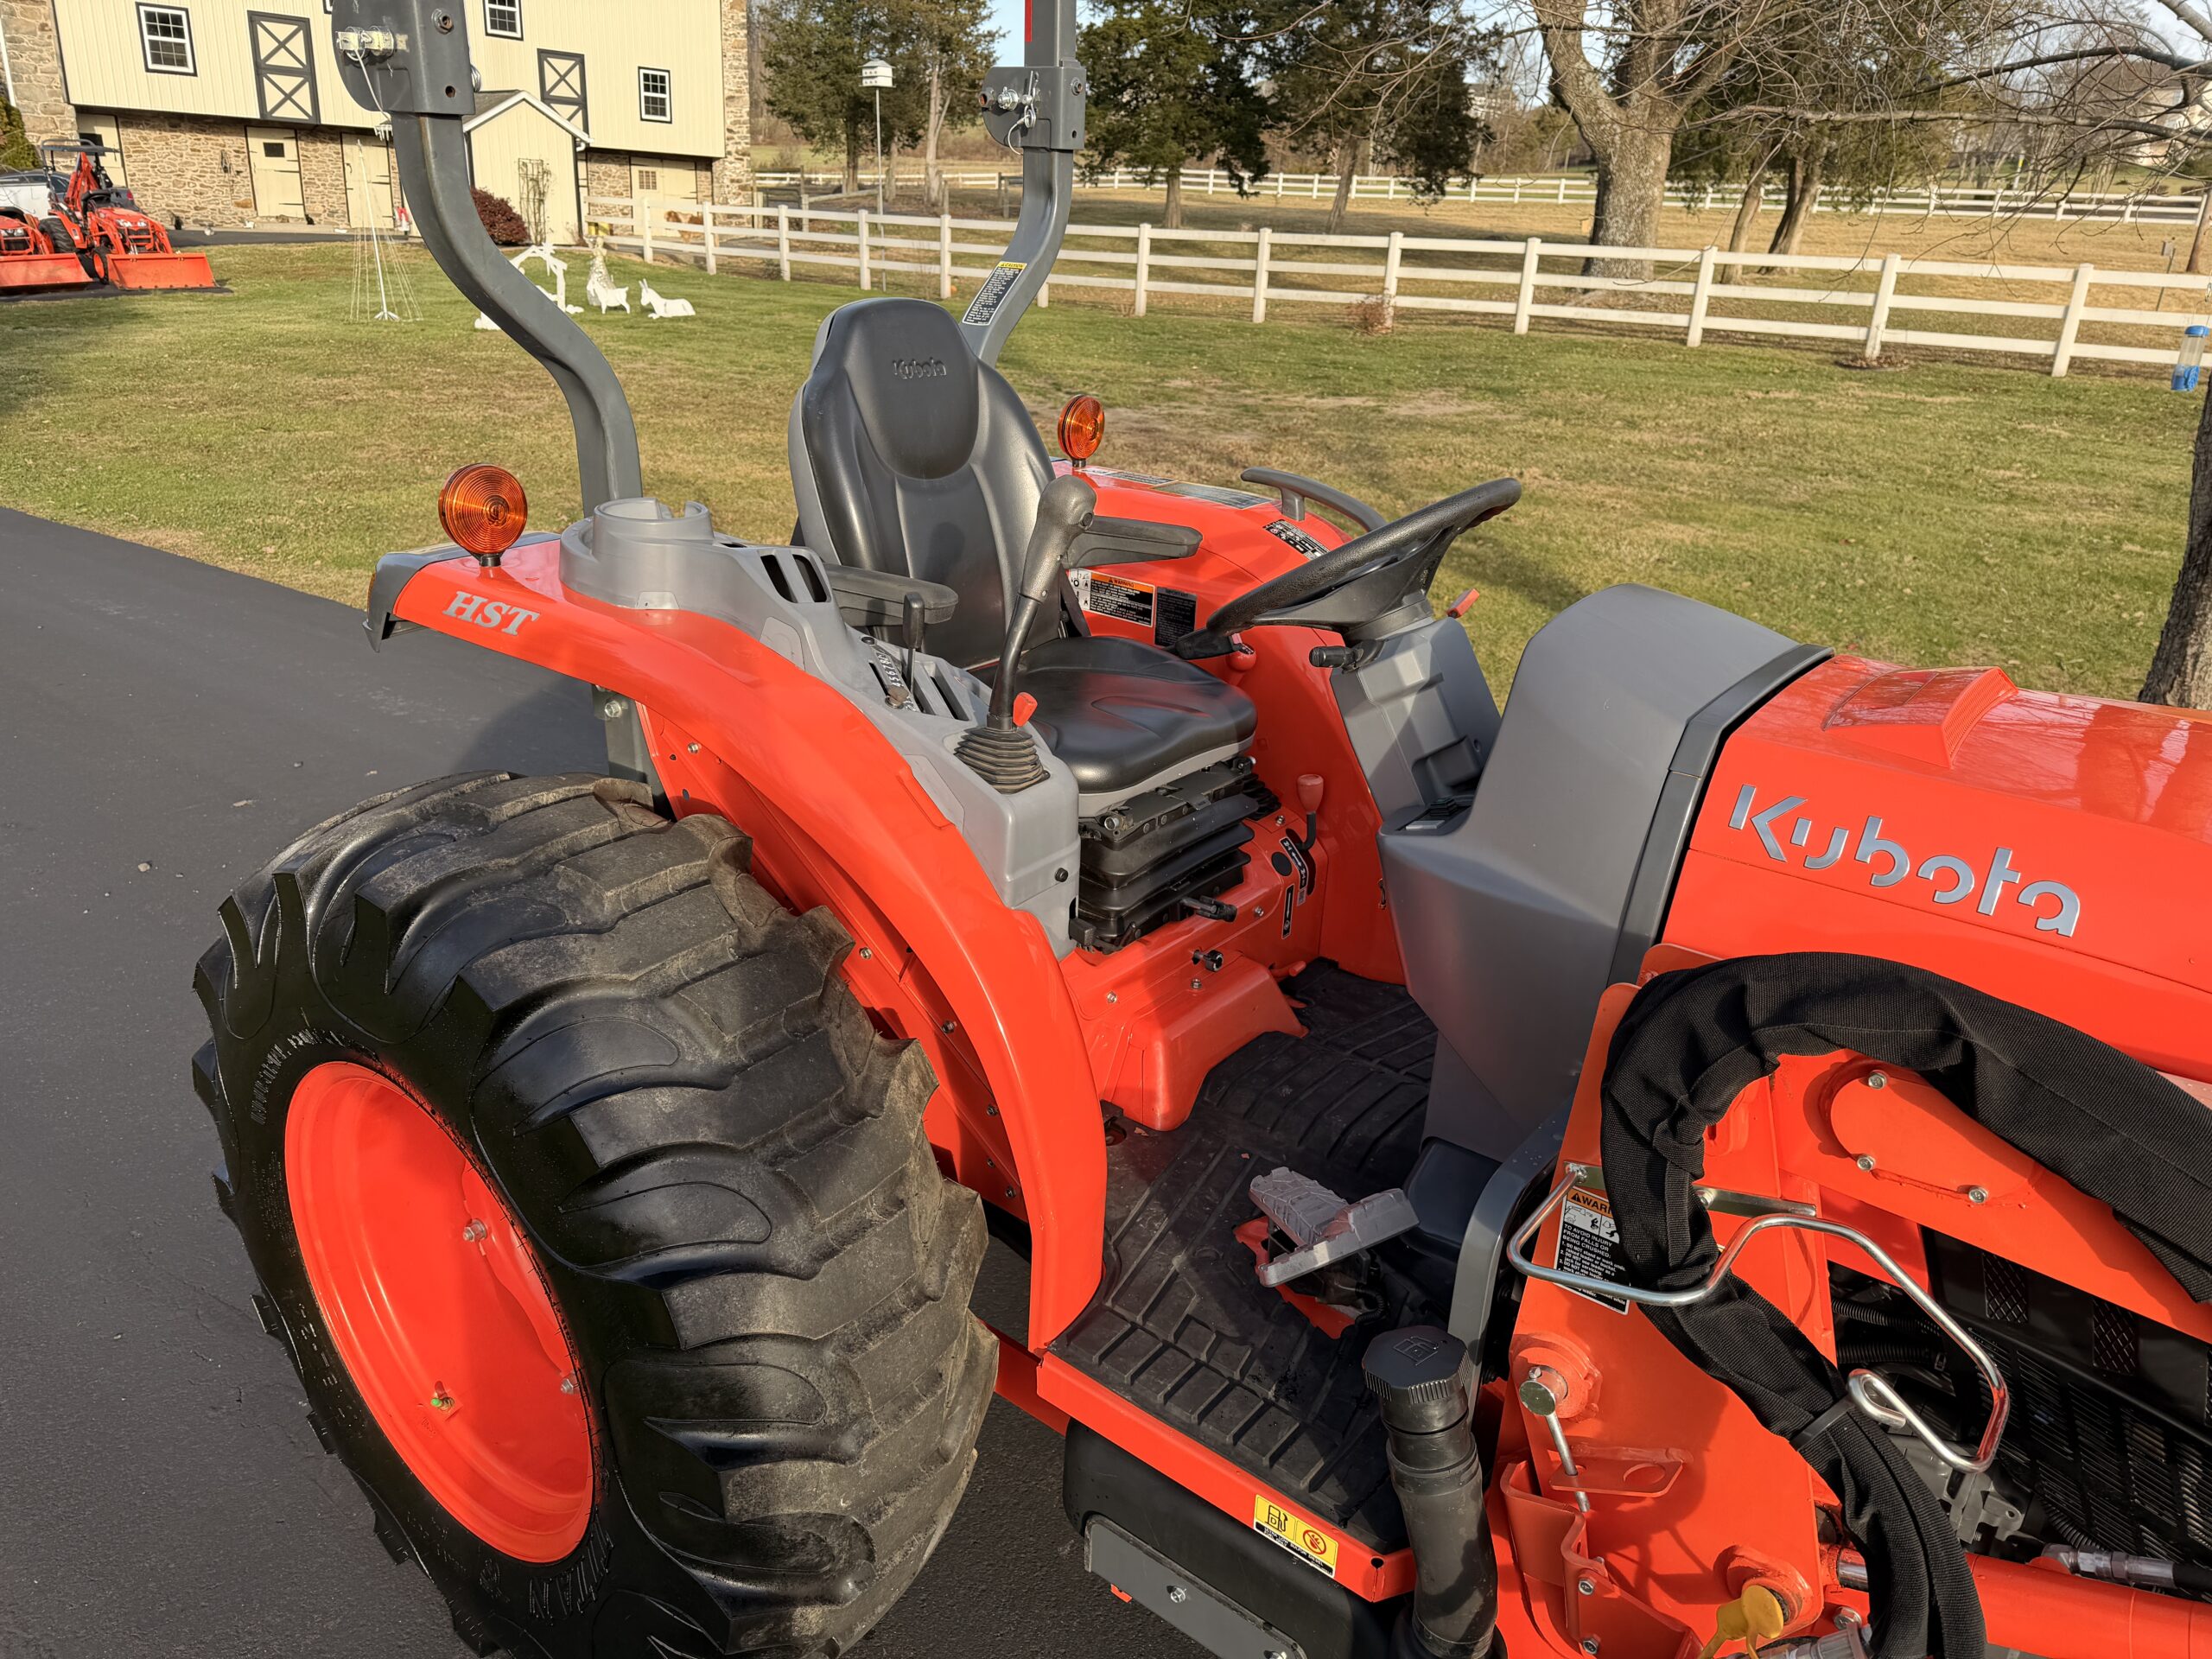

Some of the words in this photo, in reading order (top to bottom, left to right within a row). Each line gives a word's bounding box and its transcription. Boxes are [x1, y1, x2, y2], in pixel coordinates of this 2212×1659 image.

[442, 590, 540, 636] HST
[1728, 784, 2081, 938] Kubota
[1562, 1234, 1580, 1245] BEING
[1581, 1243, 1611, 1259] CRUSHED:
[1563, 1229, 1580, 1240] FROM
[1580, 1236, 1599, 1248] FALLS
[1573, 1228, 1591, 1238] AVOID
[1591, 1235, 1612, 1247] INJURY
